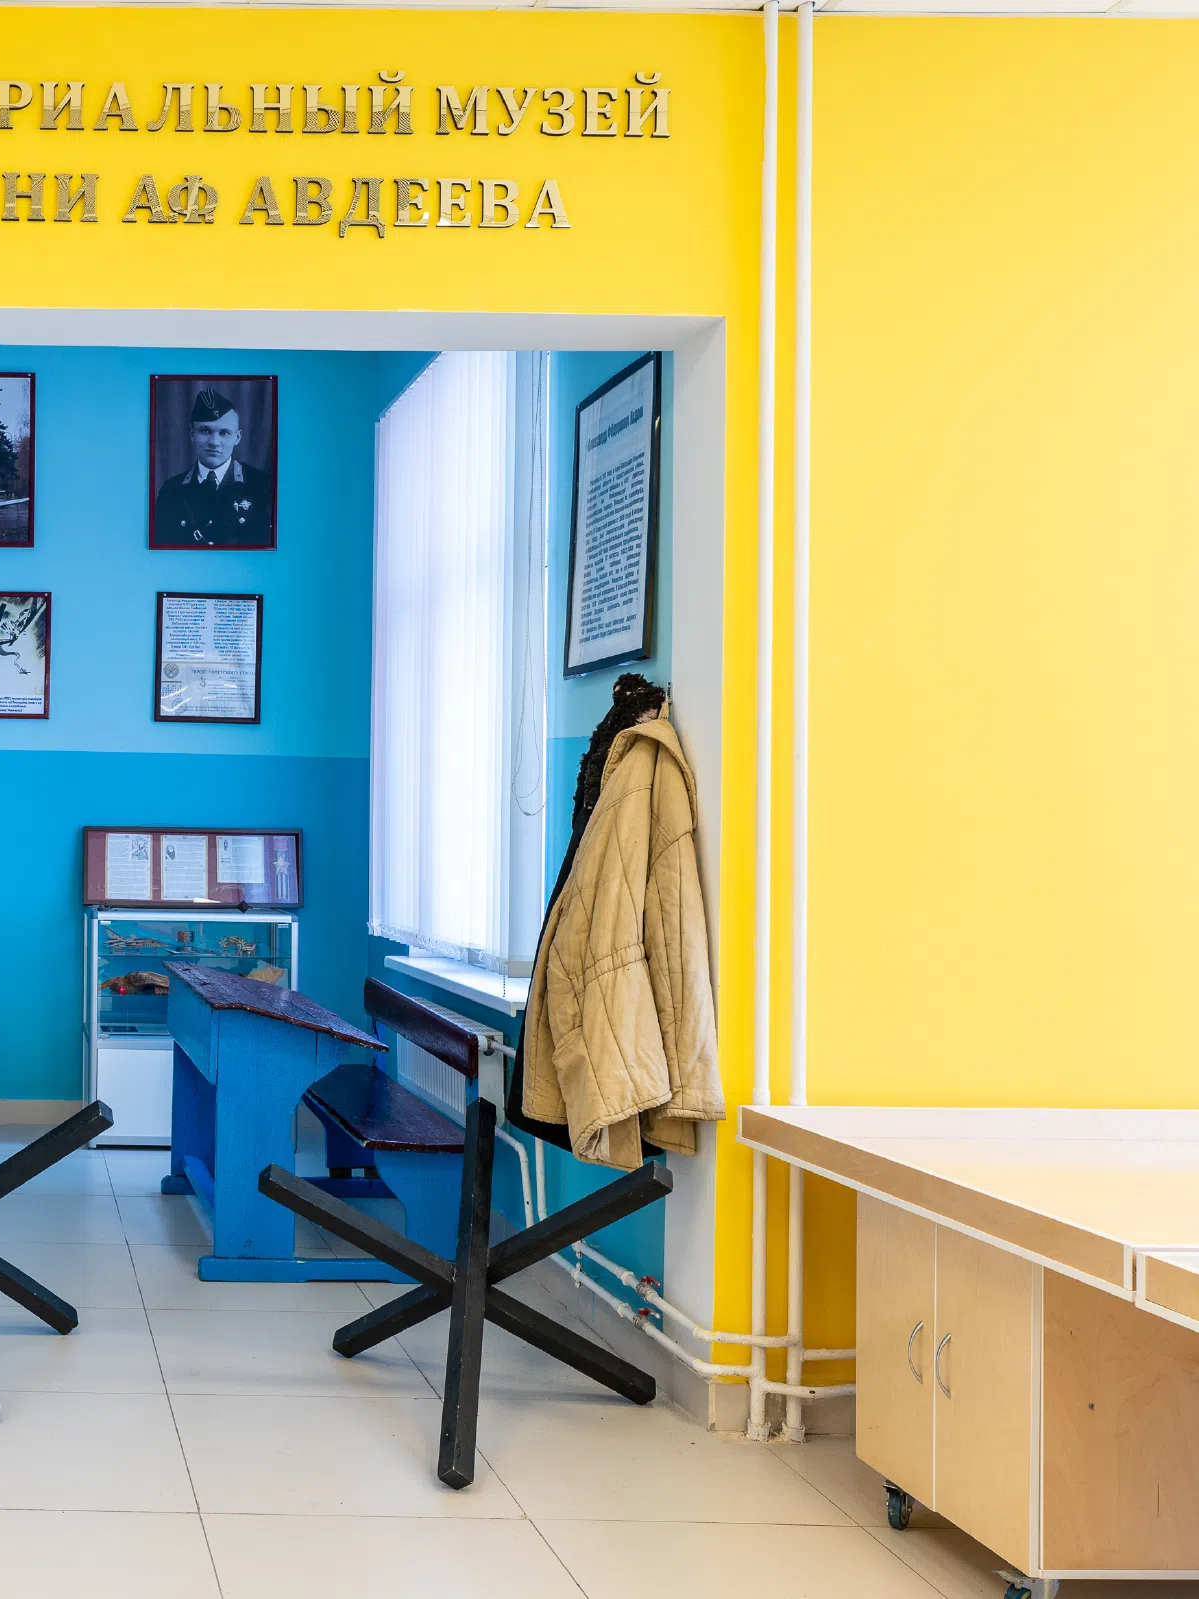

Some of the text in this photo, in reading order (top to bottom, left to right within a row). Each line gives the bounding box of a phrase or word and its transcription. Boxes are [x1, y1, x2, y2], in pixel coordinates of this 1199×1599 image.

[436, 71, 673, 139] МУЗЕЙ
[122, 173, 219, 225] А.Ф.
[239, 175, 574, 240] АВДЕЕВА
